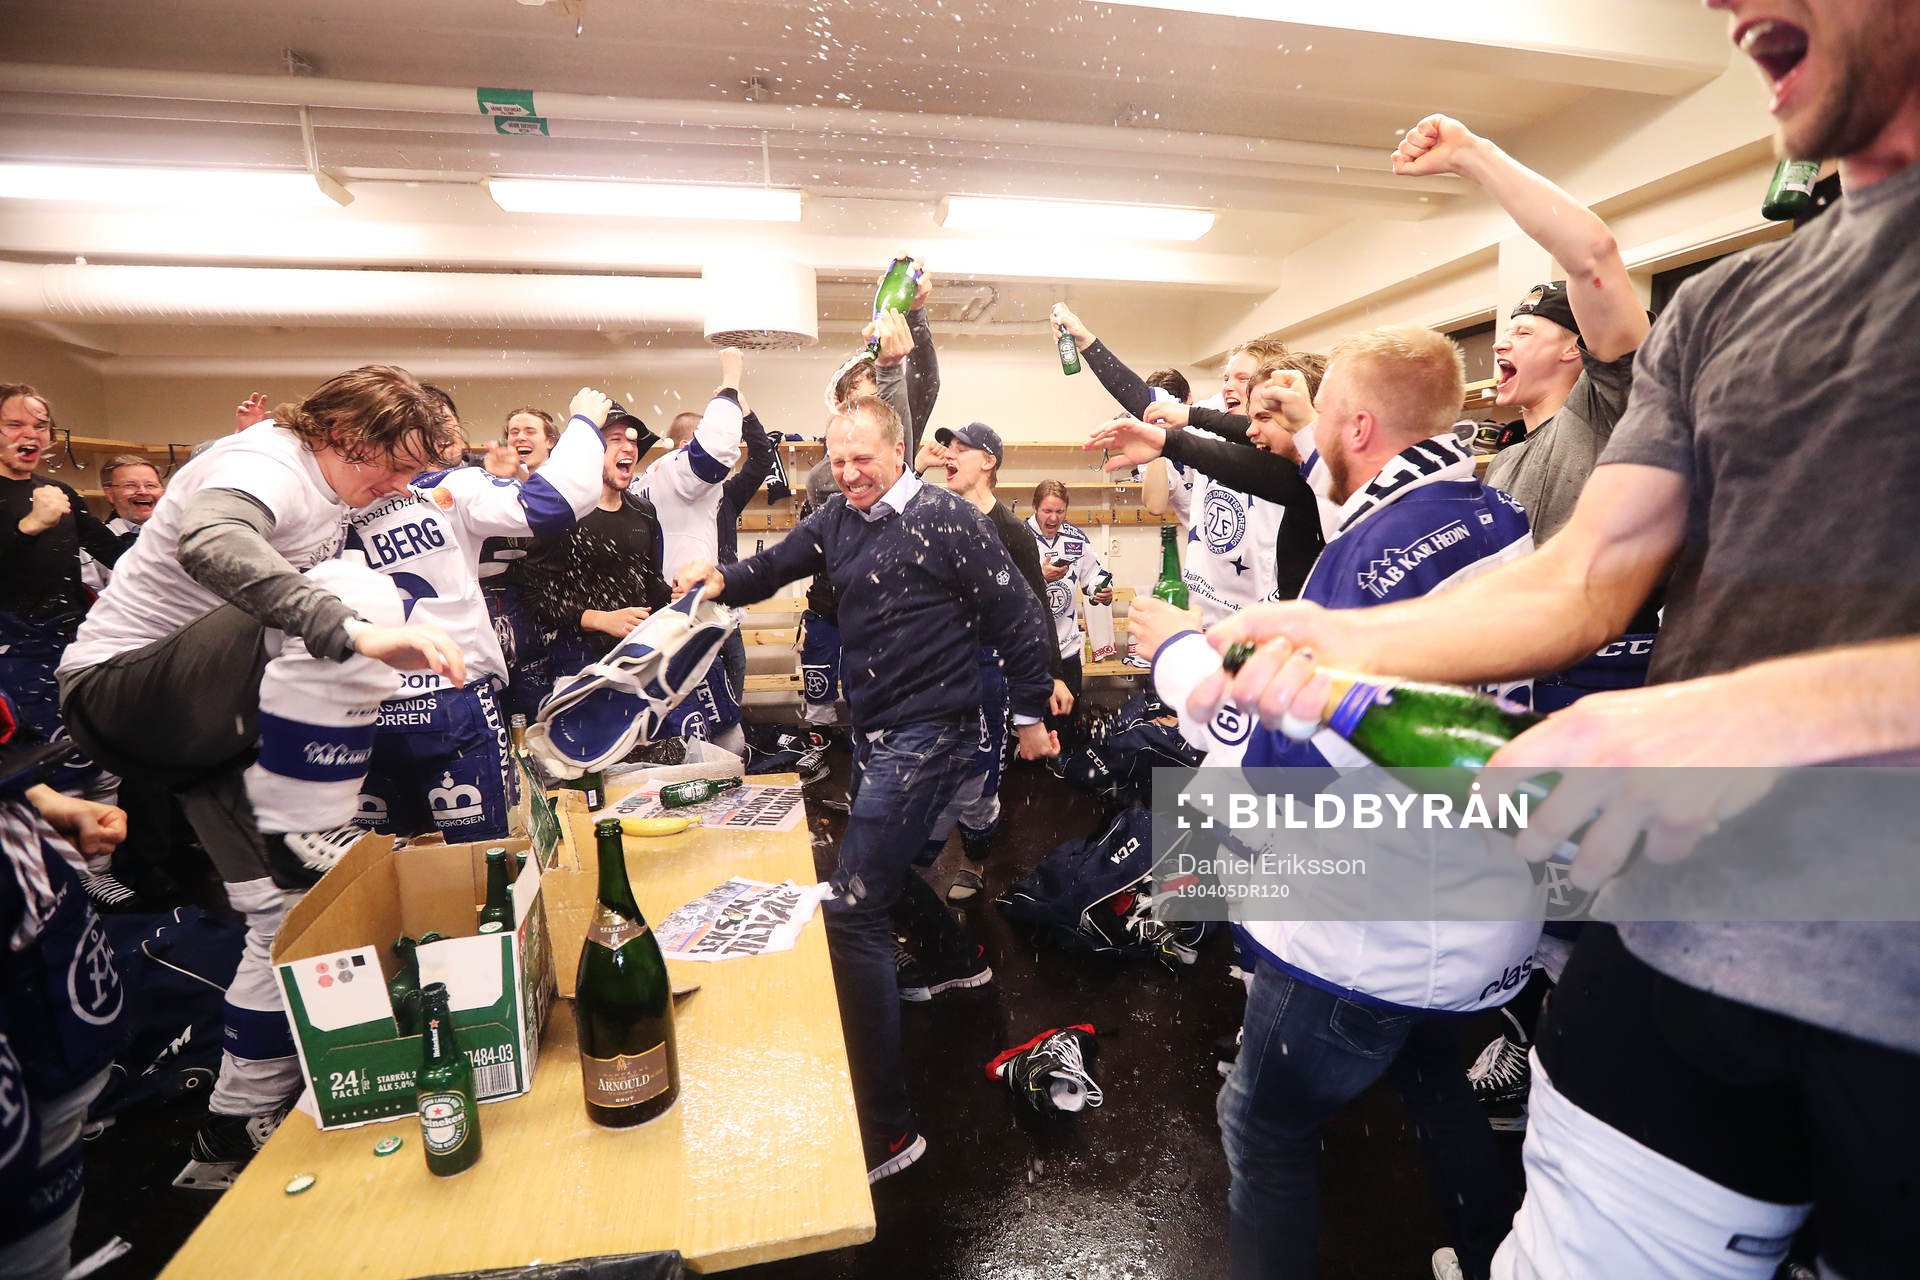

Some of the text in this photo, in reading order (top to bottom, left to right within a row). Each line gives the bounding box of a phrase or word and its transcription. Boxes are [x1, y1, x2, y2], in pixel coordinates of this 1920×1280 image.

[1380, 525, 1471, 593] AB KARL HEDIN
[1596, 640, 1654, 656] CC
[400, 673, 440, 689] son
[376, 711, 432, 726] ÖRREN
[1086, 748, 1110, 776] CCM
[330, 1070, 359, 1091] 24
[377, 1071, 411, 1084] STARKÖL
[378, 1079, 415, 1092] ALK 5,0%
[598, 1074, 650, 1092] ARNOULD
[332, 1088, 360, 1099] PACK
